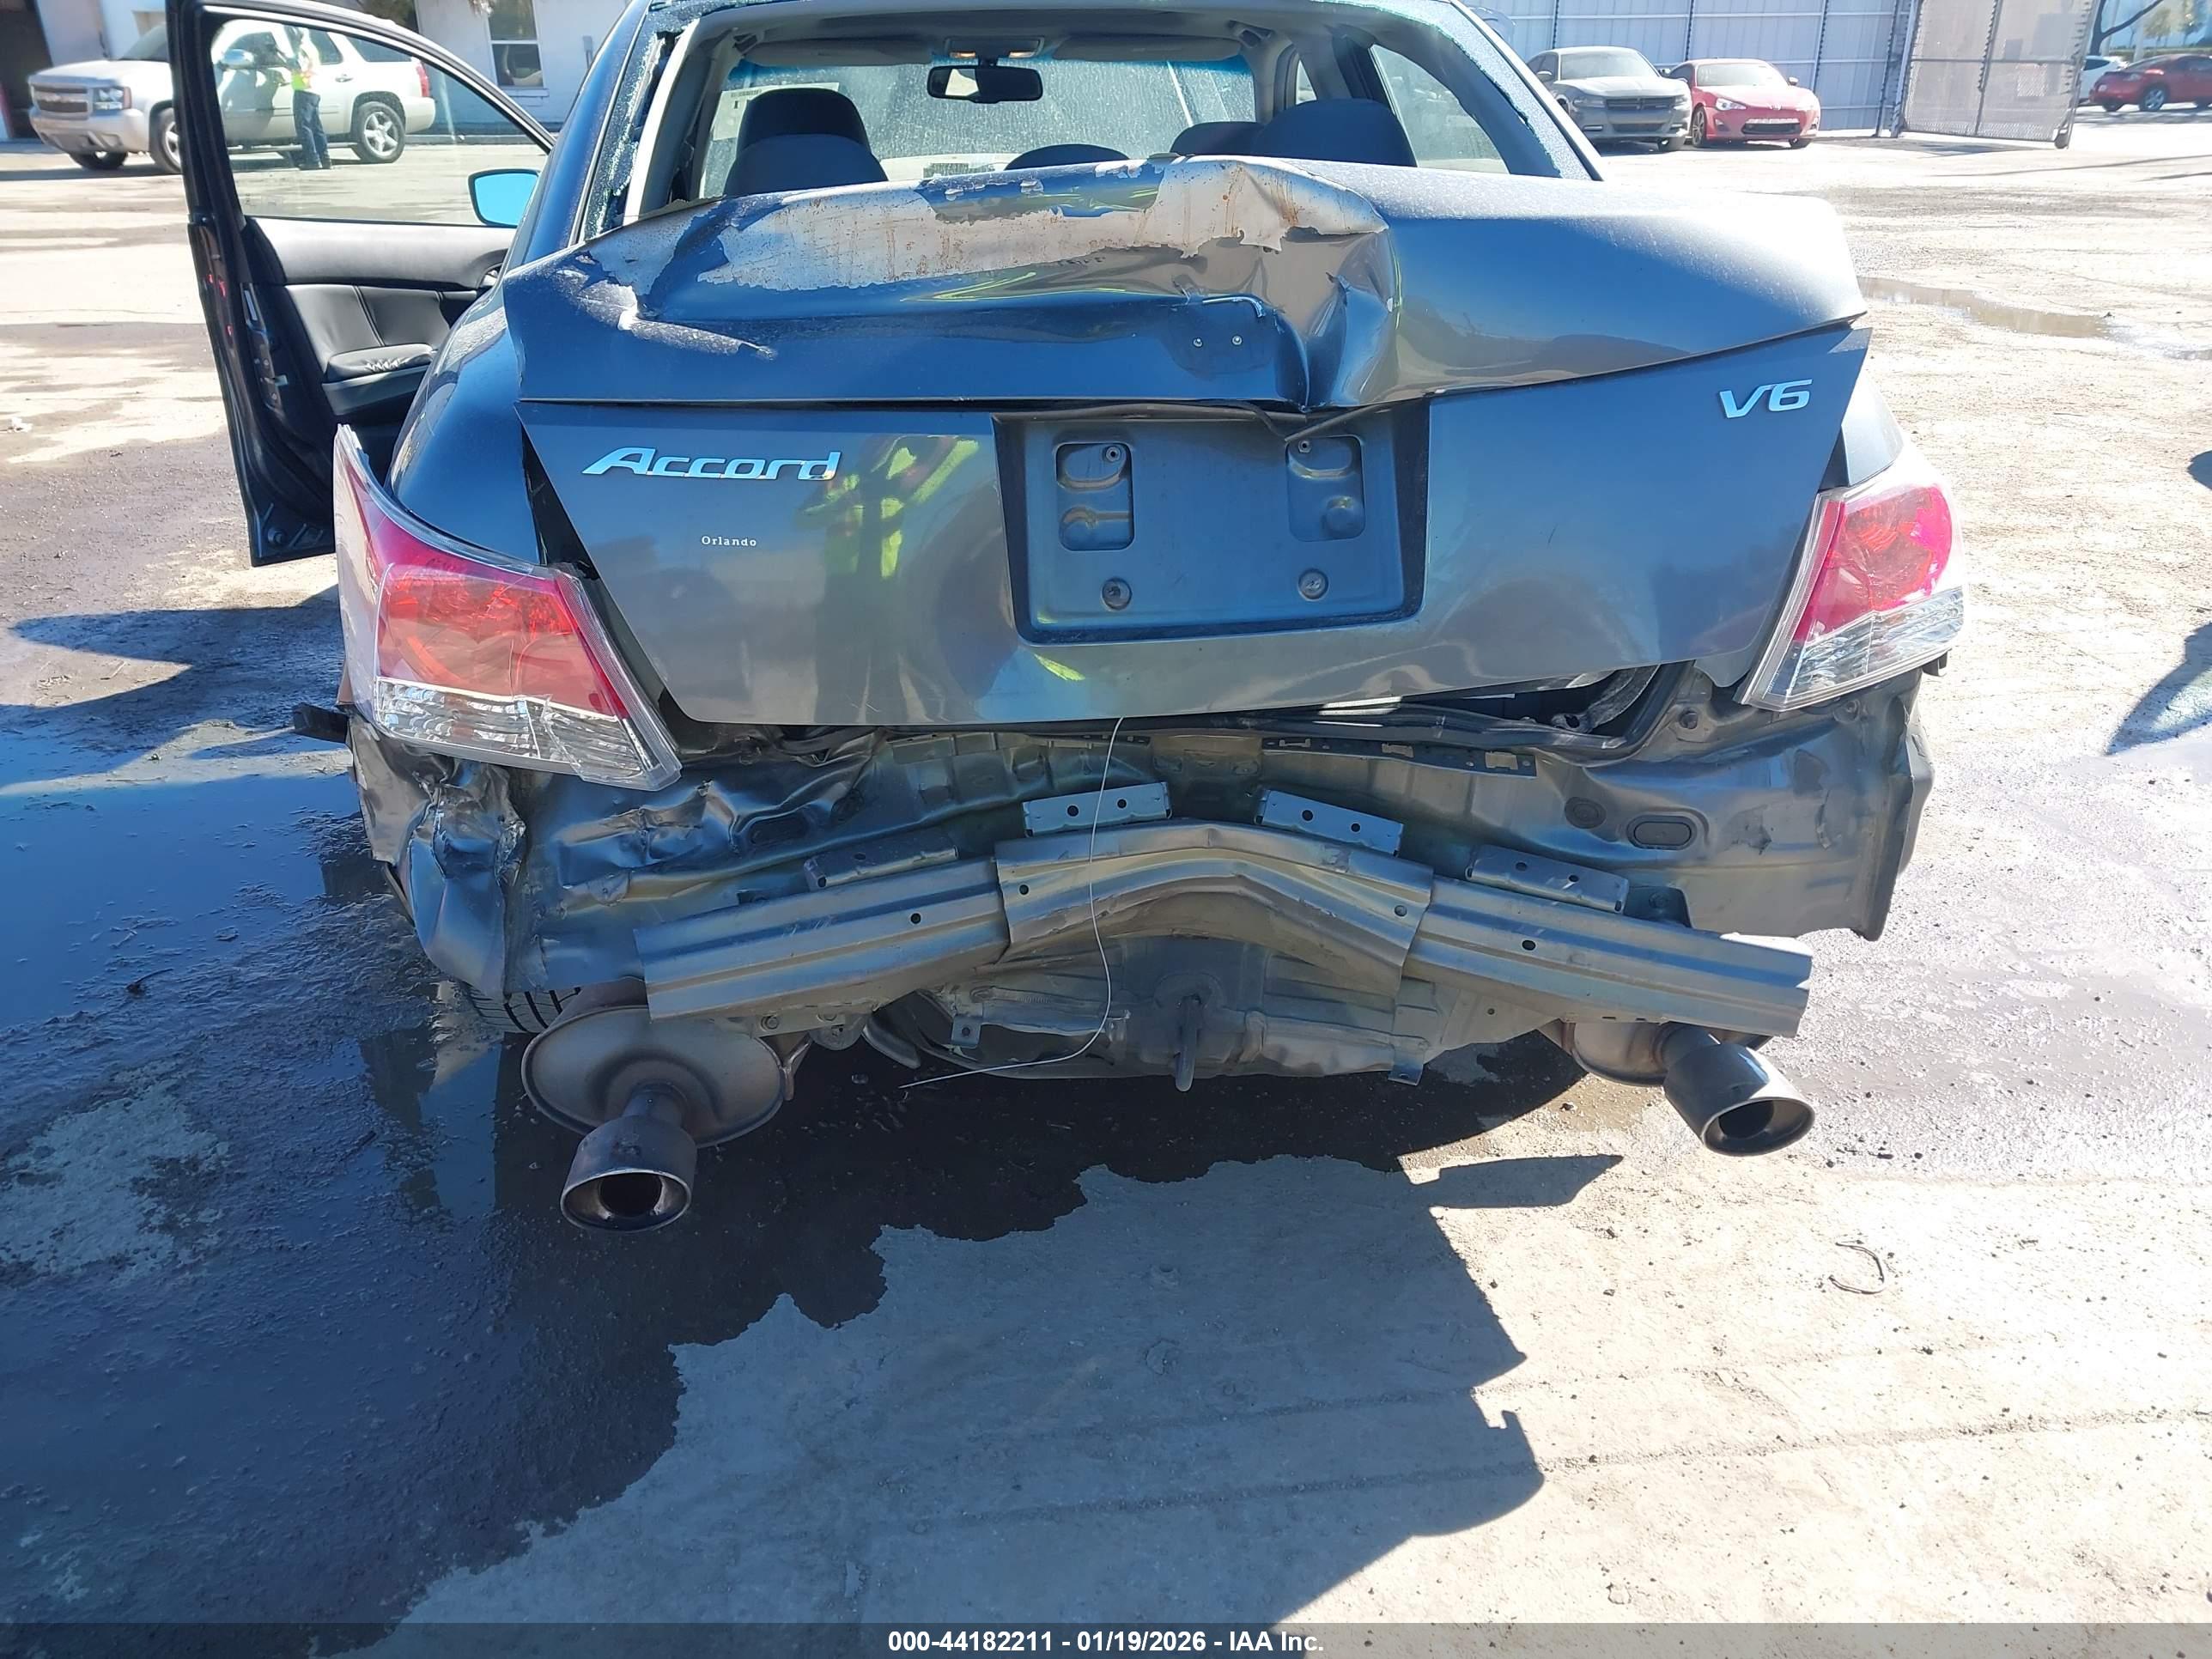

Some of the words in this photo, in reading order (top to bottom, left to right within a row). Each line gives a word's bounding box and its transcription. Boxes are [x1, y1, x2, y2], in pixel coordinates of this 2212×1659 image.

[1719, 379, 1813, 419] V6
[582, 447, 842, 481] Accord
[701, 535, 757, 547] Orlando
